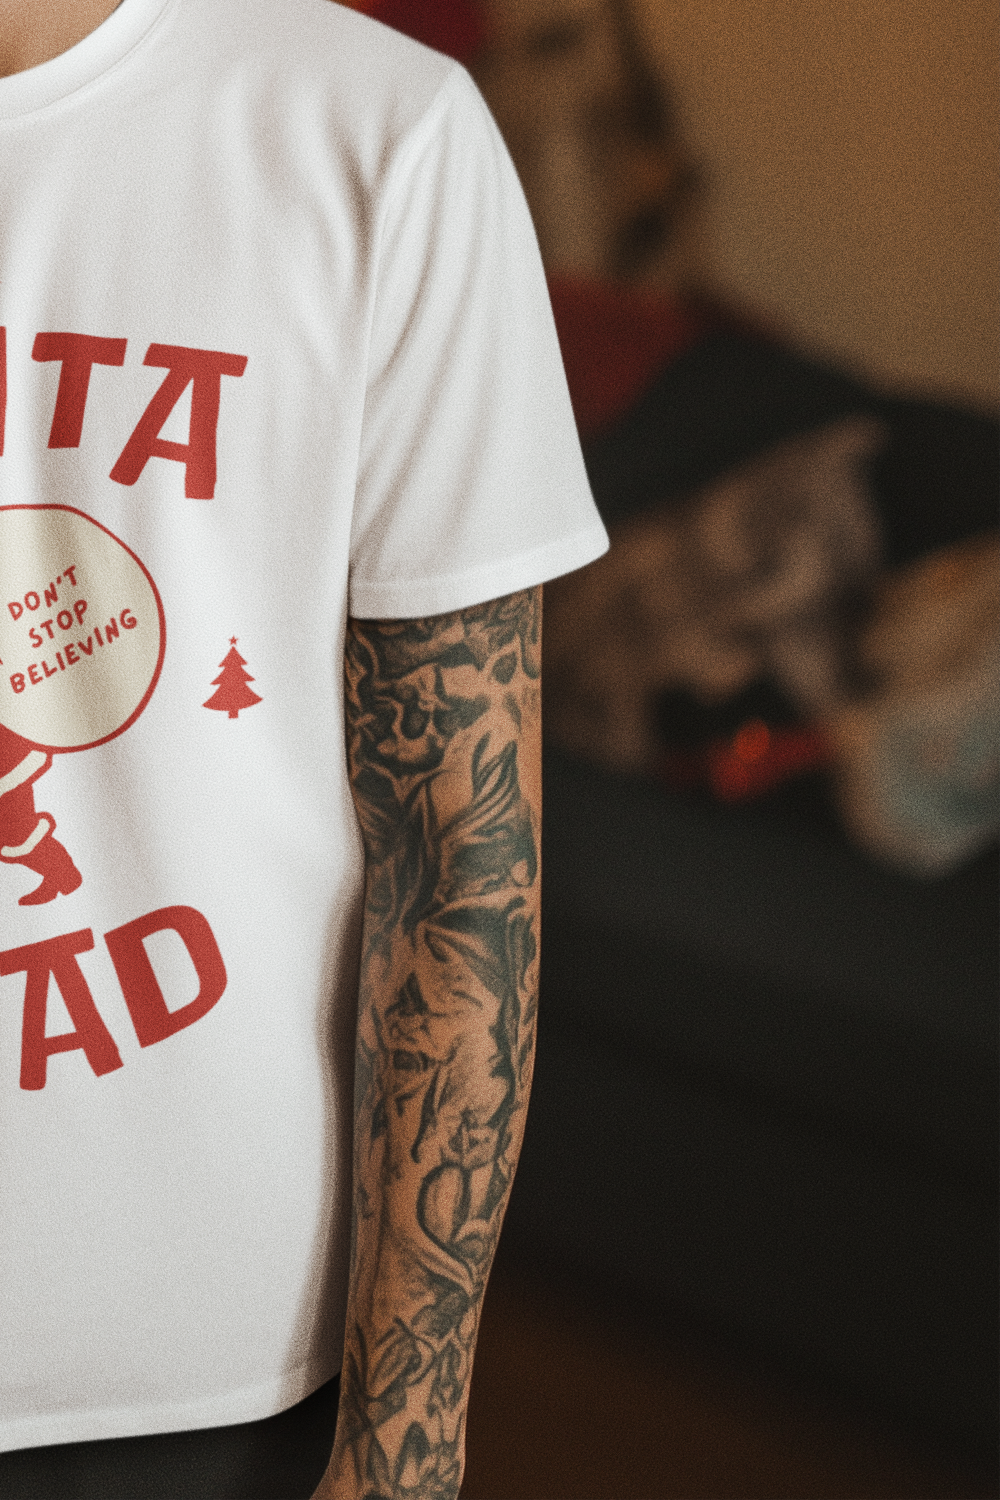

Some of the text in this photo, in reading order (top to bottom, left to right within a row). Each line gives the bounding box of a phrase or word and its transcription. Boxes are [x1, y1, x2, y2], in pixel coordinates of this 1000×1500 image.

[7, 565, 77, 621] DON'T
[9, 608, 138, 694] BELIEVING
[28, 599, 88, 648] STOP
